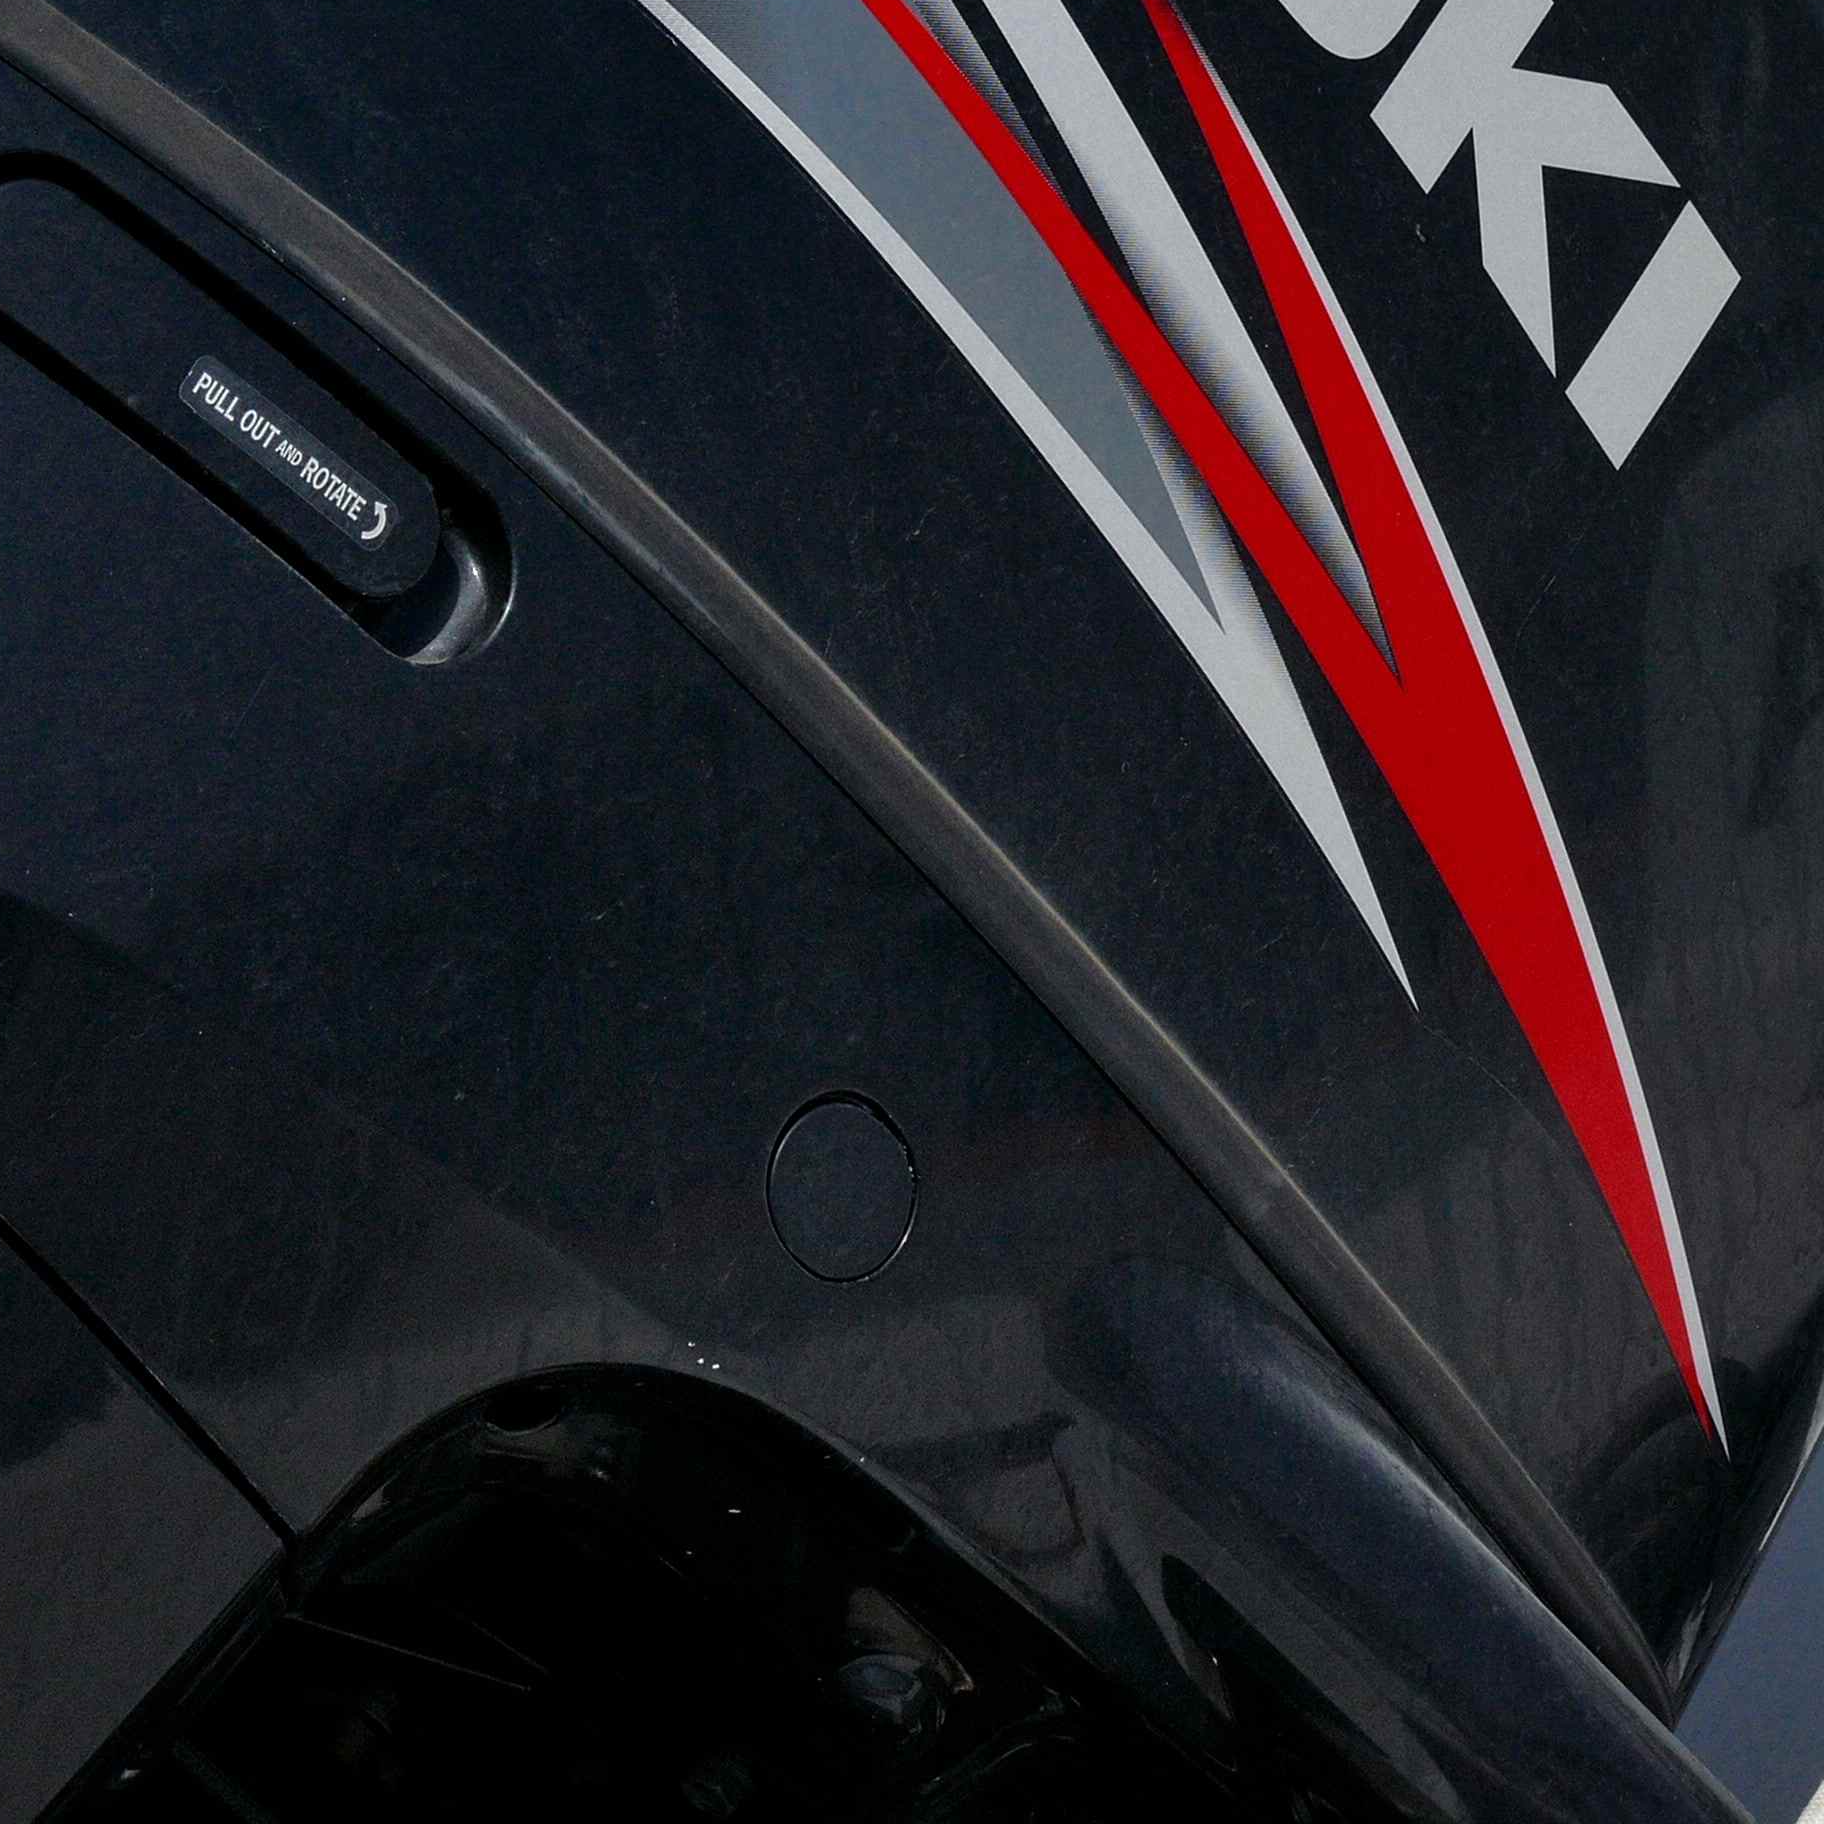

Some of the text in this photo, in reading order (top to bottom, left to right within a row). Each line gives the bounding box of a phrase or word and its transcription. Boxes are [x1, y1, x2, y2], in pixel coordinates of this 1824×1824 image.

[191, 371, 368, 521] PULL OUT AND ROTATE
